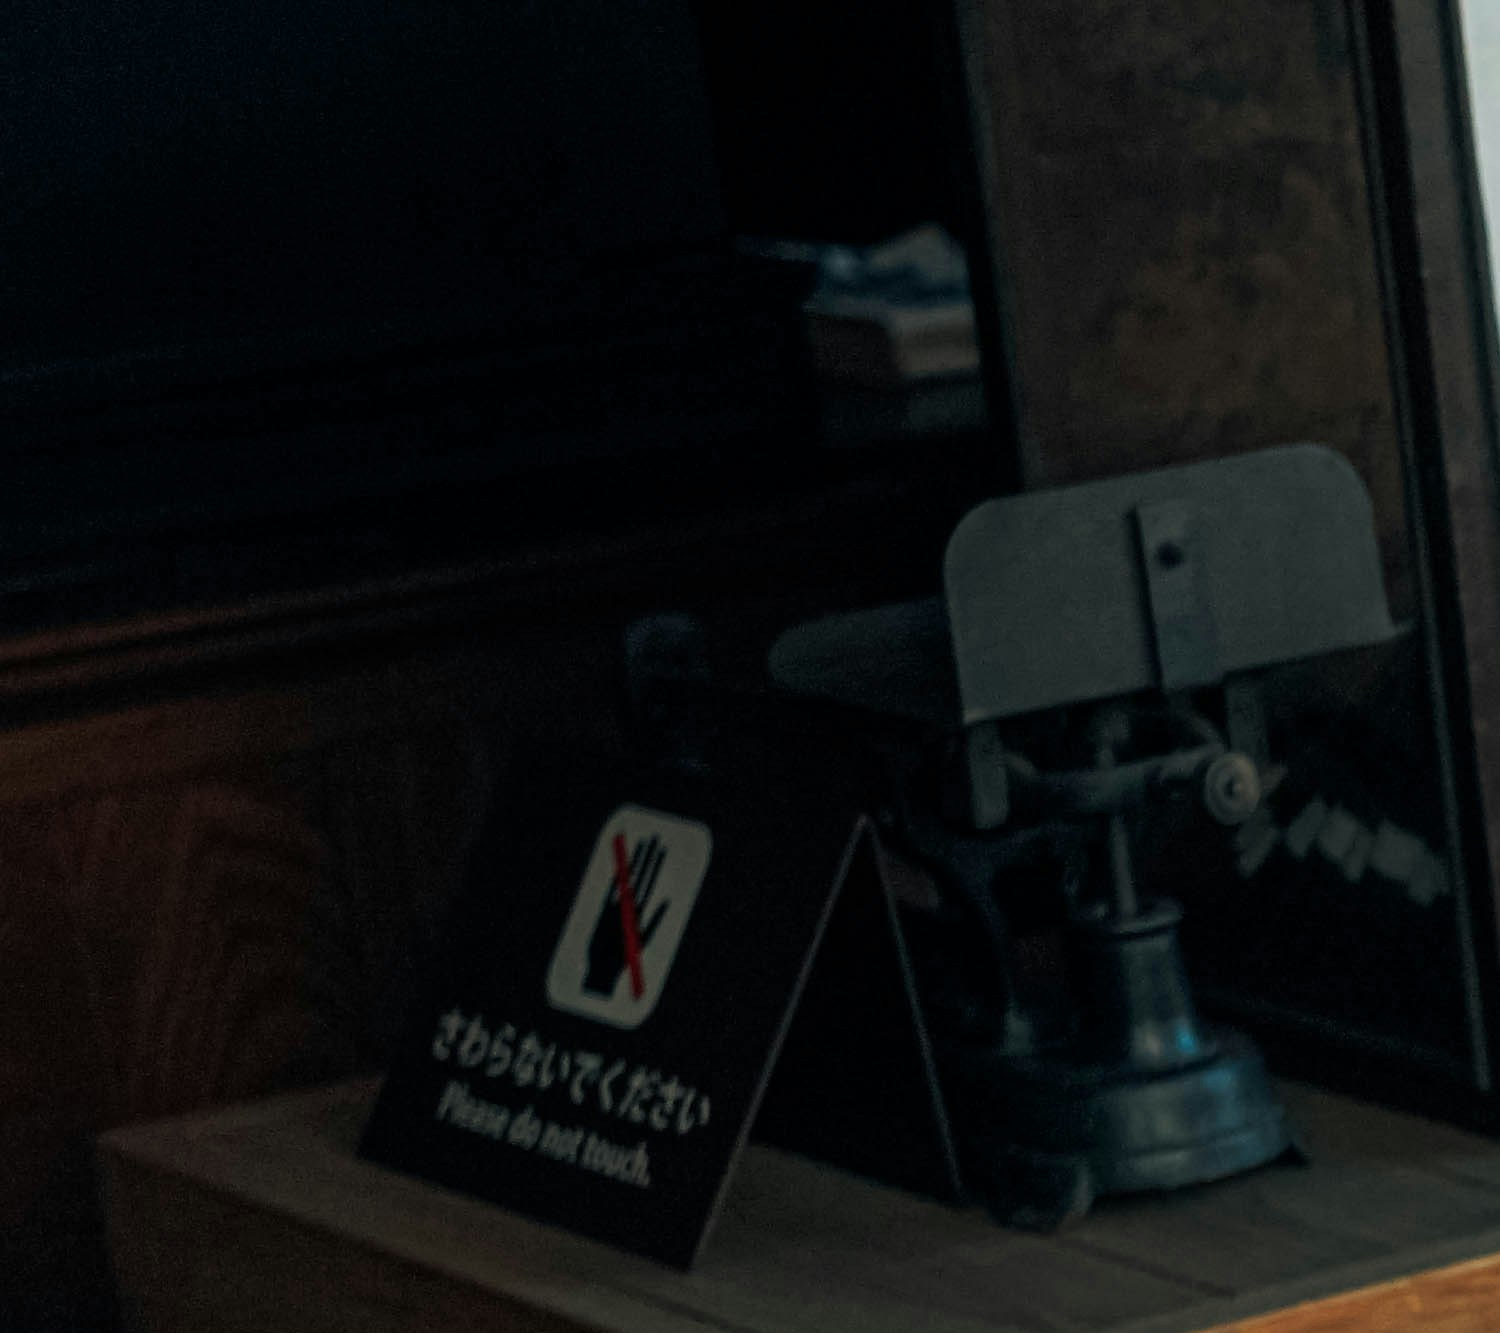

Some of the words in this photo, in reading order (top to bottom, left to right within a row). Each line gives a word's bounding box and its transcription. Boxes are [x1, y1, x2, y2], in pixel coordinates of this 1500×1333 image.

[433, 1008, 711, 1135] さわらないでください
[438, 1080, 511, 1141] Please
[509, 1106, 543, 1149] do
[540, 1122, 585, 1163] not
